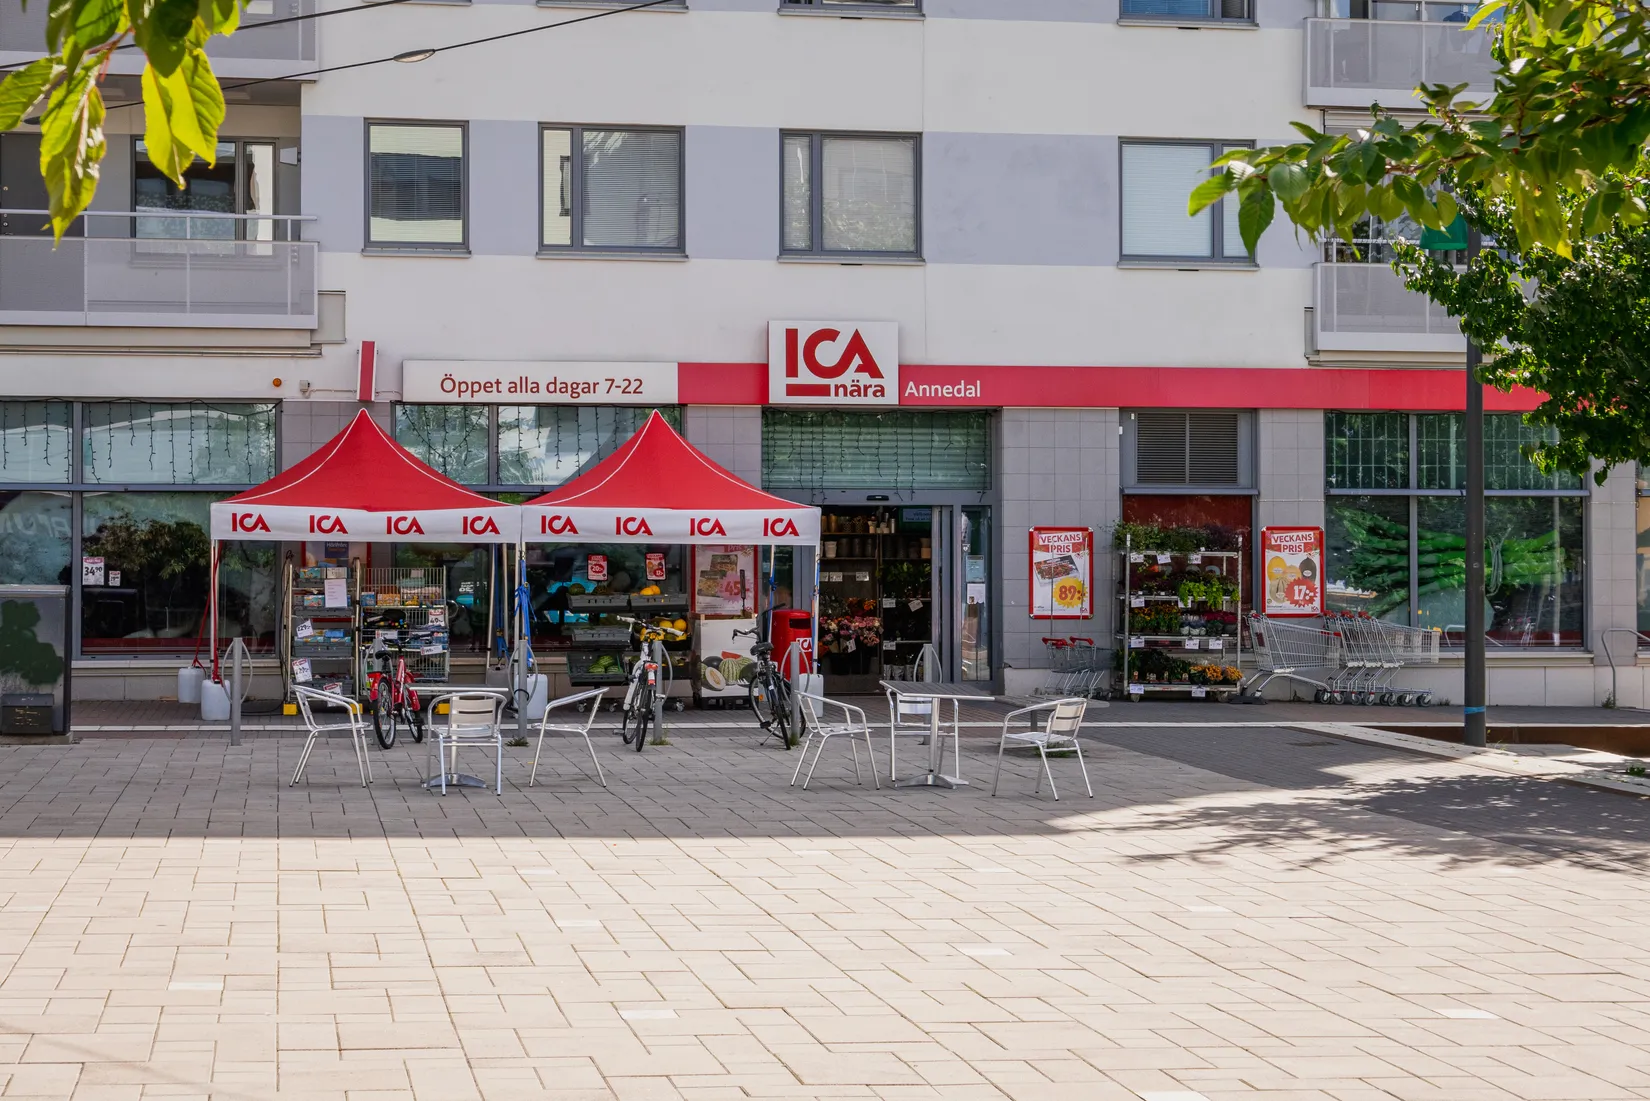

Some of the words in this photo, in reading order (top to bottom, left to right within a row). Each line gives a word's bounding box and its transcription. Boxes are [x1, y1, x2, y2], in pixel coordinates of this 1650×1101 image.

[785, 328, 885, 379] ICA
[440, 374, 502, 398] Öppet
[508, 376, 540, 394] alla
[546, 376, 599, 399] dagar
[605, 378, 643, 394] 7-22
[834, 379, 885, 398] nära
[904, 380, 981, 397] Annedal
[231, 512, 271, 533] ICA
[309, 514, 348, 534] ICA
[386, 516, 424, 535] ICA
[462, 516, 500, 535] ICA
[541, 515, 578, 535] ICA
[615, 516, 653, 536] ICA
[689, 517, 727, 537] ICA
[763, 517, 799, 537] ICA
[1040, 533, 1081, 544] VECKANS
[1272, 533, 1313, 543] VECKANS
[1050, 544, 1071, 553] PRIS
[1282, 544, 1303, 553] PRIS
[1293, 585, 1314, 600] 17:-
